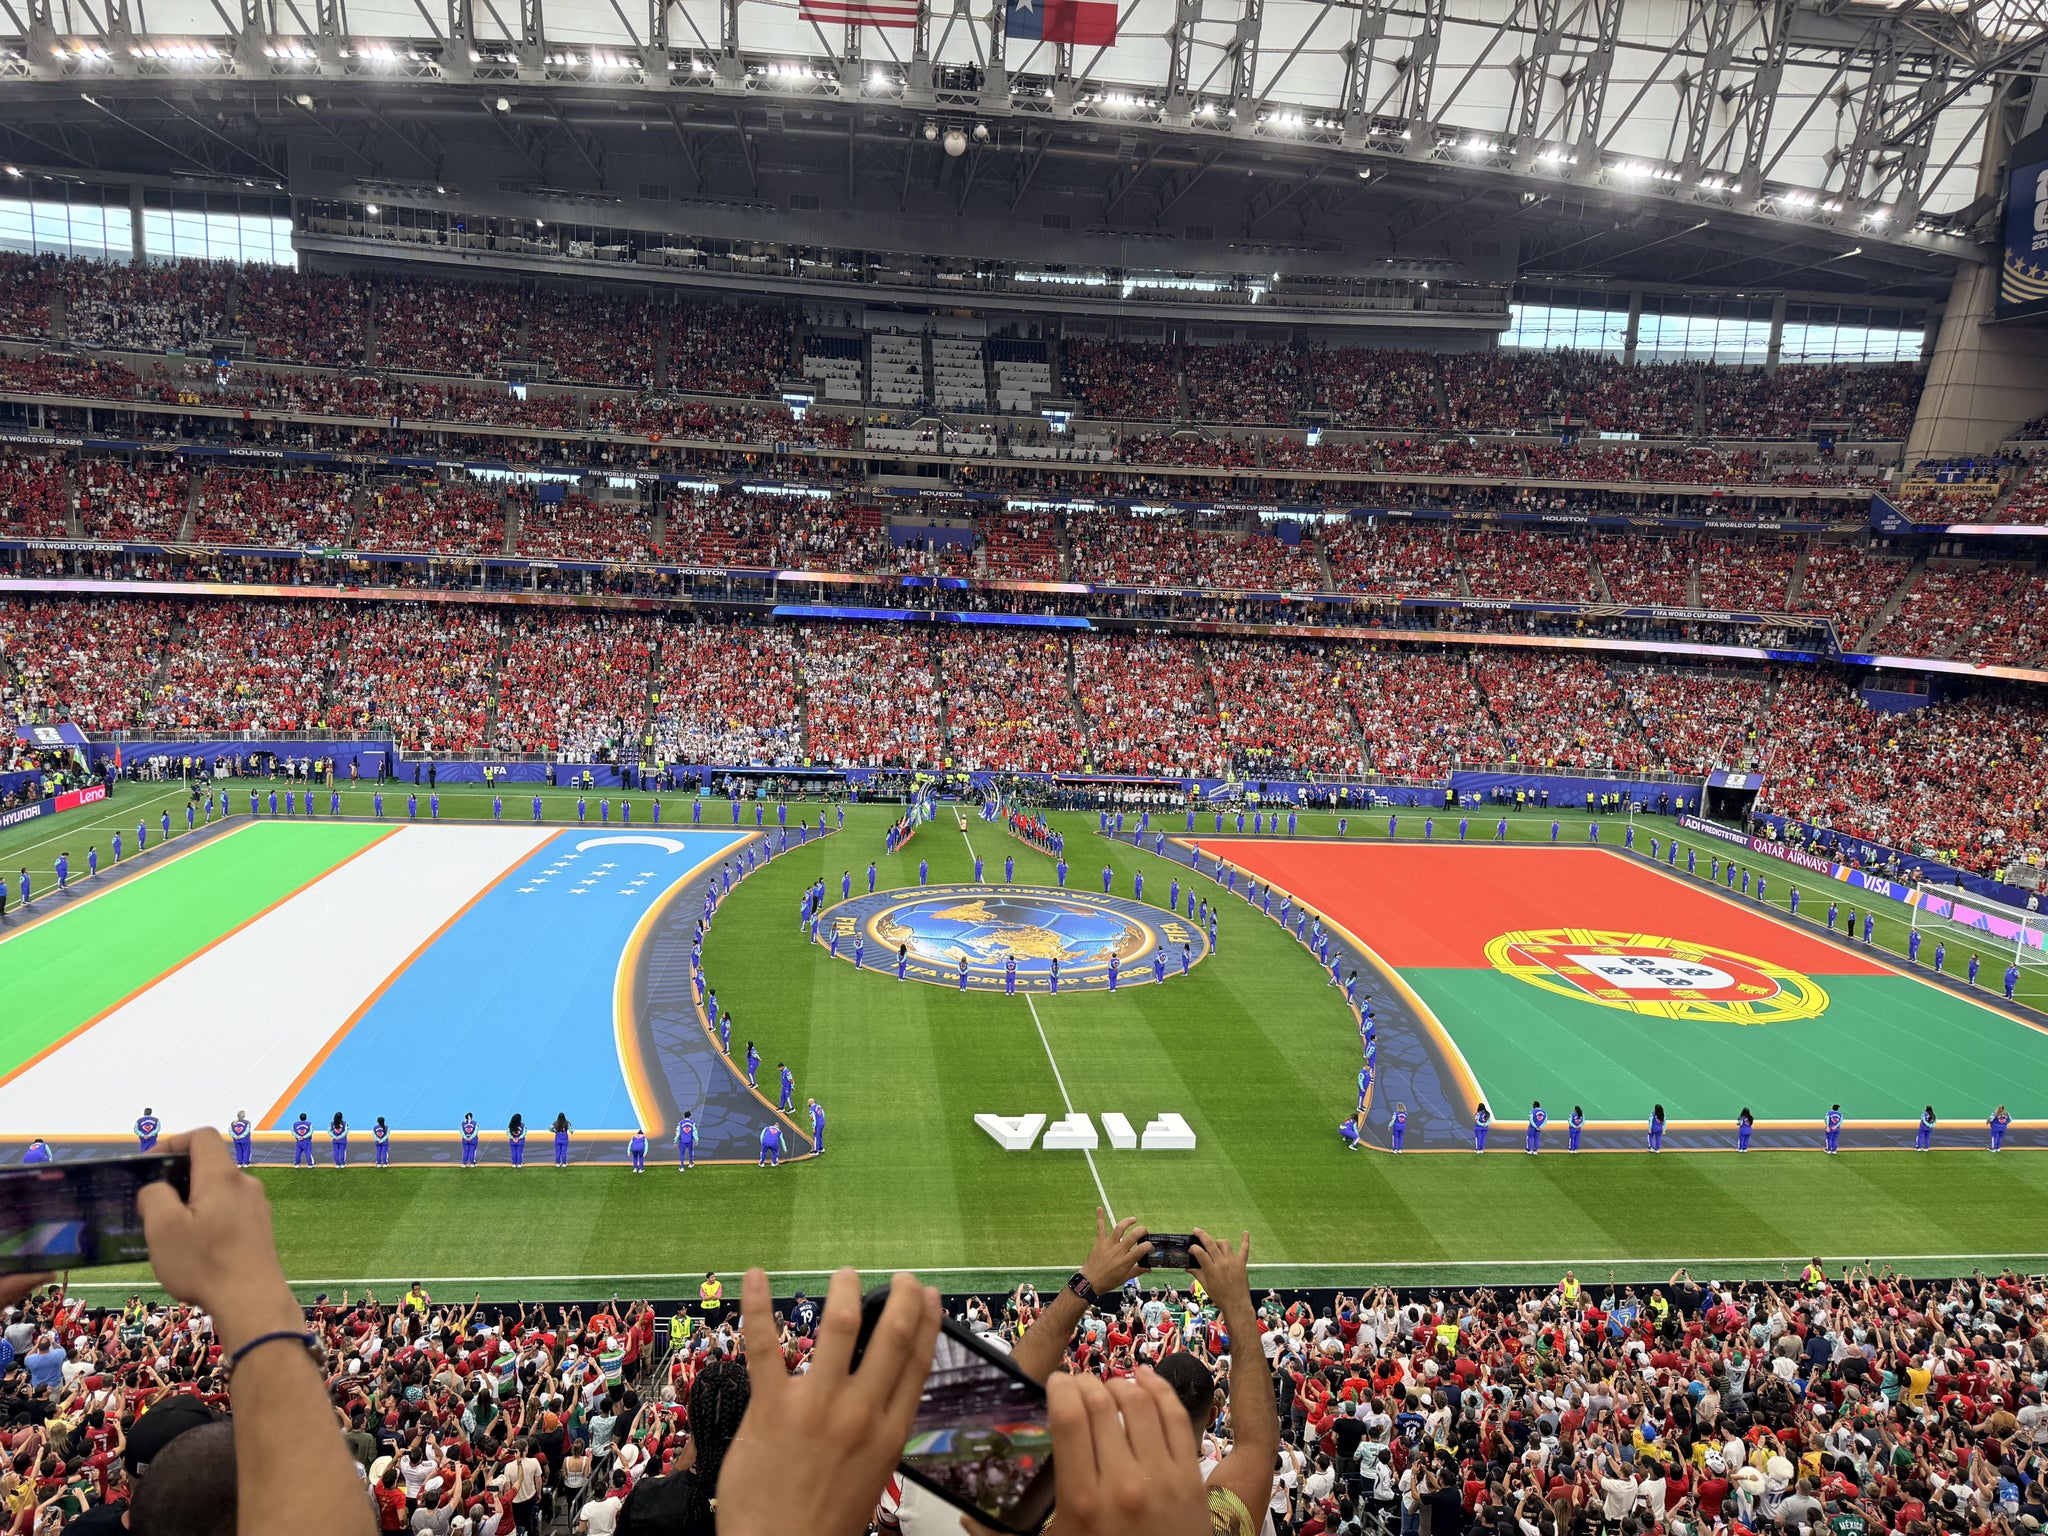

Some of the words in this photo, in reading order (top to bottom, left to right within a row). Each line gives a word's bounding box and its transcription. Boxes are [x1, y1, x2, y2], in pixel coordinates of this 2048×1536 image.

[229, 449, 284, 457] HOUSTON
[919, 490, 963, 498] HOUSTON
[3, 805, 41, 826] HYUNDAI
[1701, 824, 1748, 845] PREDICTSTREET
[1753, 839, 1784, 857] QATAR
[1787, 851, 1828, 874] AIRWAYS
[1004, 887, 1066, 898] WORLD
[1863, 875, 1891, 897] VISA
[891, 887, 953, 900] 2026
[1071, 893, 1113, 905] FIFA
[835, 916, 857, 936] FIFA
[1159, 922, 1191, 943] FIFA
[974, 1112, 1197, 1150] FIFA
[800, 1309, 814, 1324] 19
[1424, 1335, 1430, 1347] 7
[481, 1356, 488, 1369] 7
[1682, 1366, 1688, 1377] 7
[1968, 1381, 1975, 1393] 7
[1512, 1389, 1519, 1401] 7
[1406, 1426, 1417, 1440] 14
[99, 1438, 107, 1451] 7
[1839, 1519, 1864, 1530] MÉXICO
